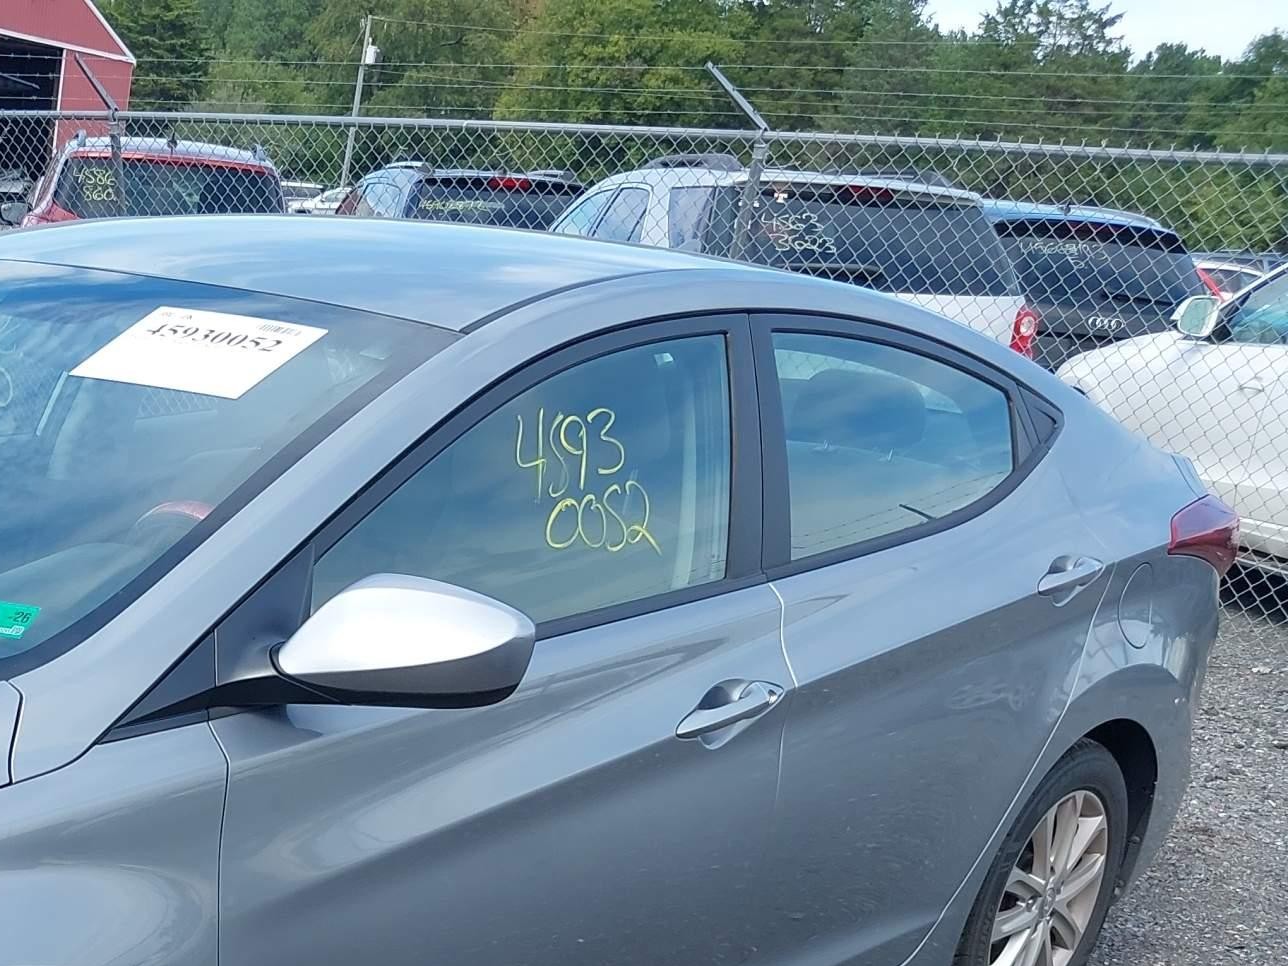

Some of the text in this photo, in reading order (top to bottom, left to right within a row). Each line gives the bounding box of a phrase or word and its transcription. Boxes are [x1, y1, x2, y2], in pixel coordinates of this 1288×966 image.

[145, 321, 284, 353] 45930052
[516, 407, 625, 501] 4593
[545, 480, 662, 556] 0052
